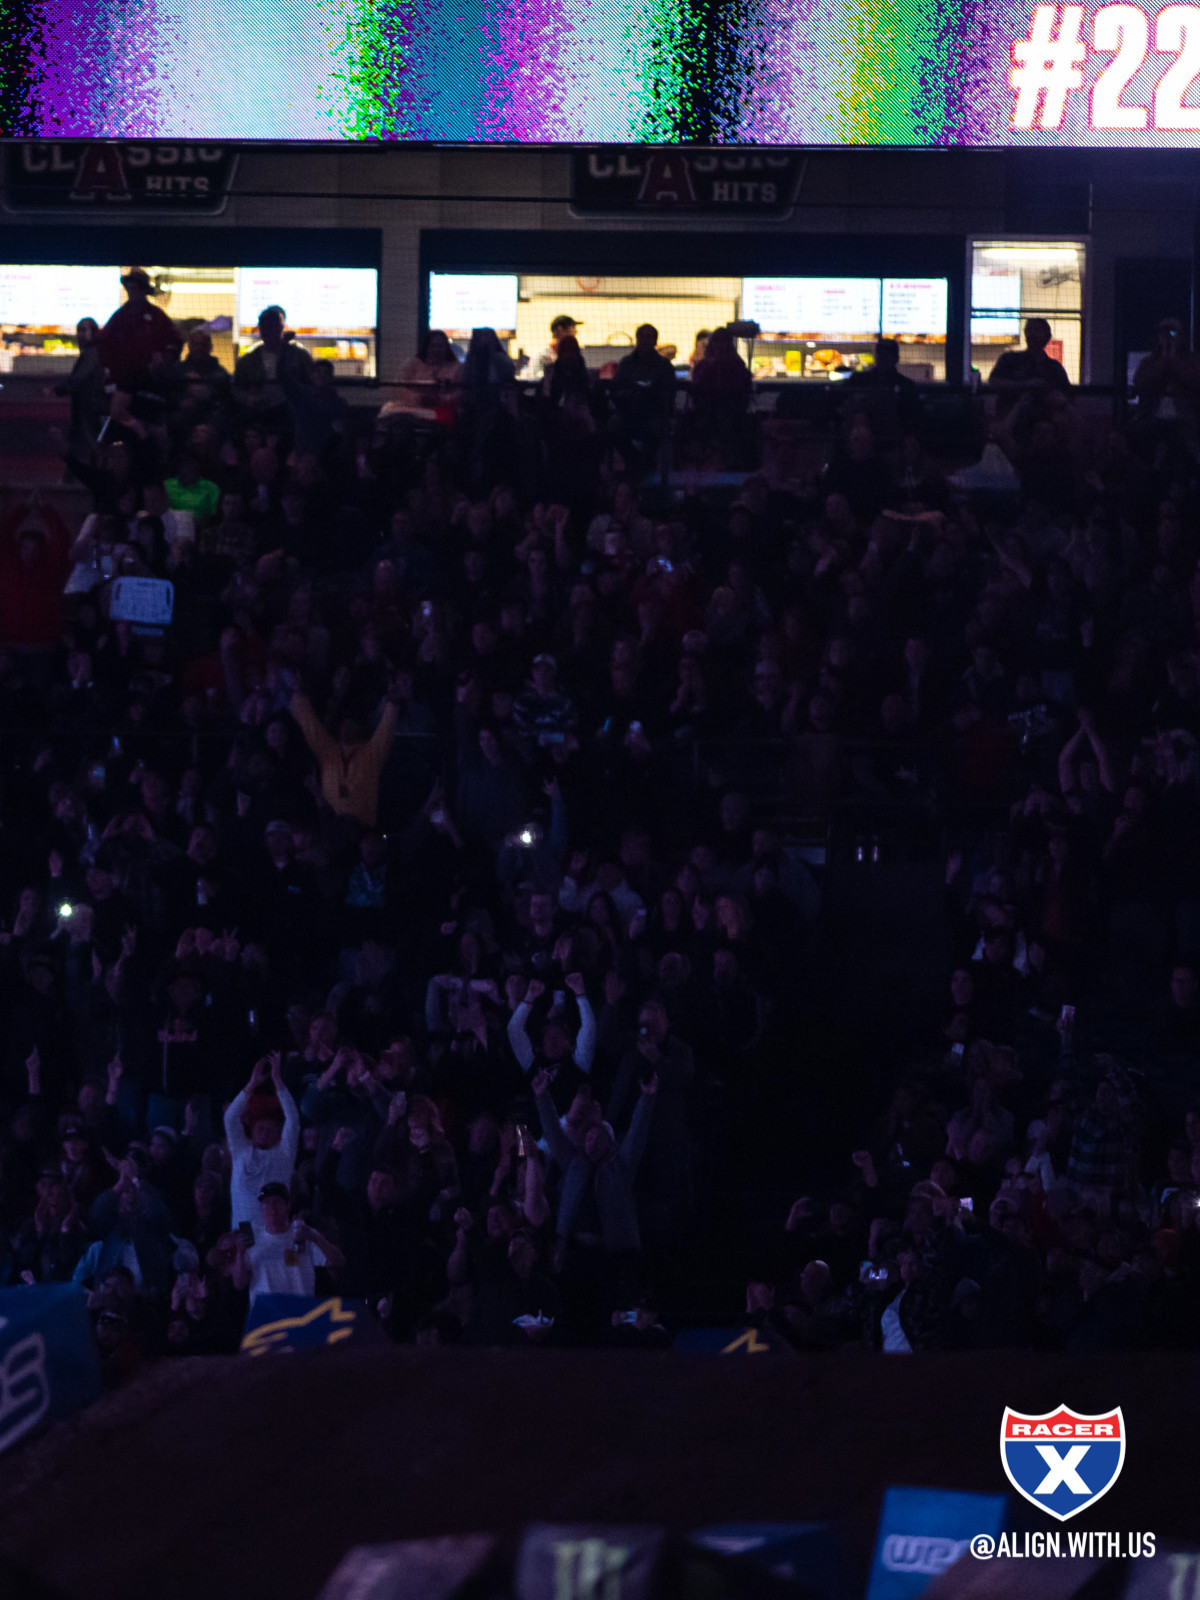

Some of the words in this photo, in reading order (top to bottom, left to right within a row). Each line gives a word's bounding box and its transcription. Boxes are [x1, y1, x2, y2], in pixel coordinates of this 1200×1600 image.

[1008, 2, 1200, 132] #22
[145, 176, 209, 197] HITS
[711, 181, 777, 202] HITS
[881, 1534, 972, 1574] WP
